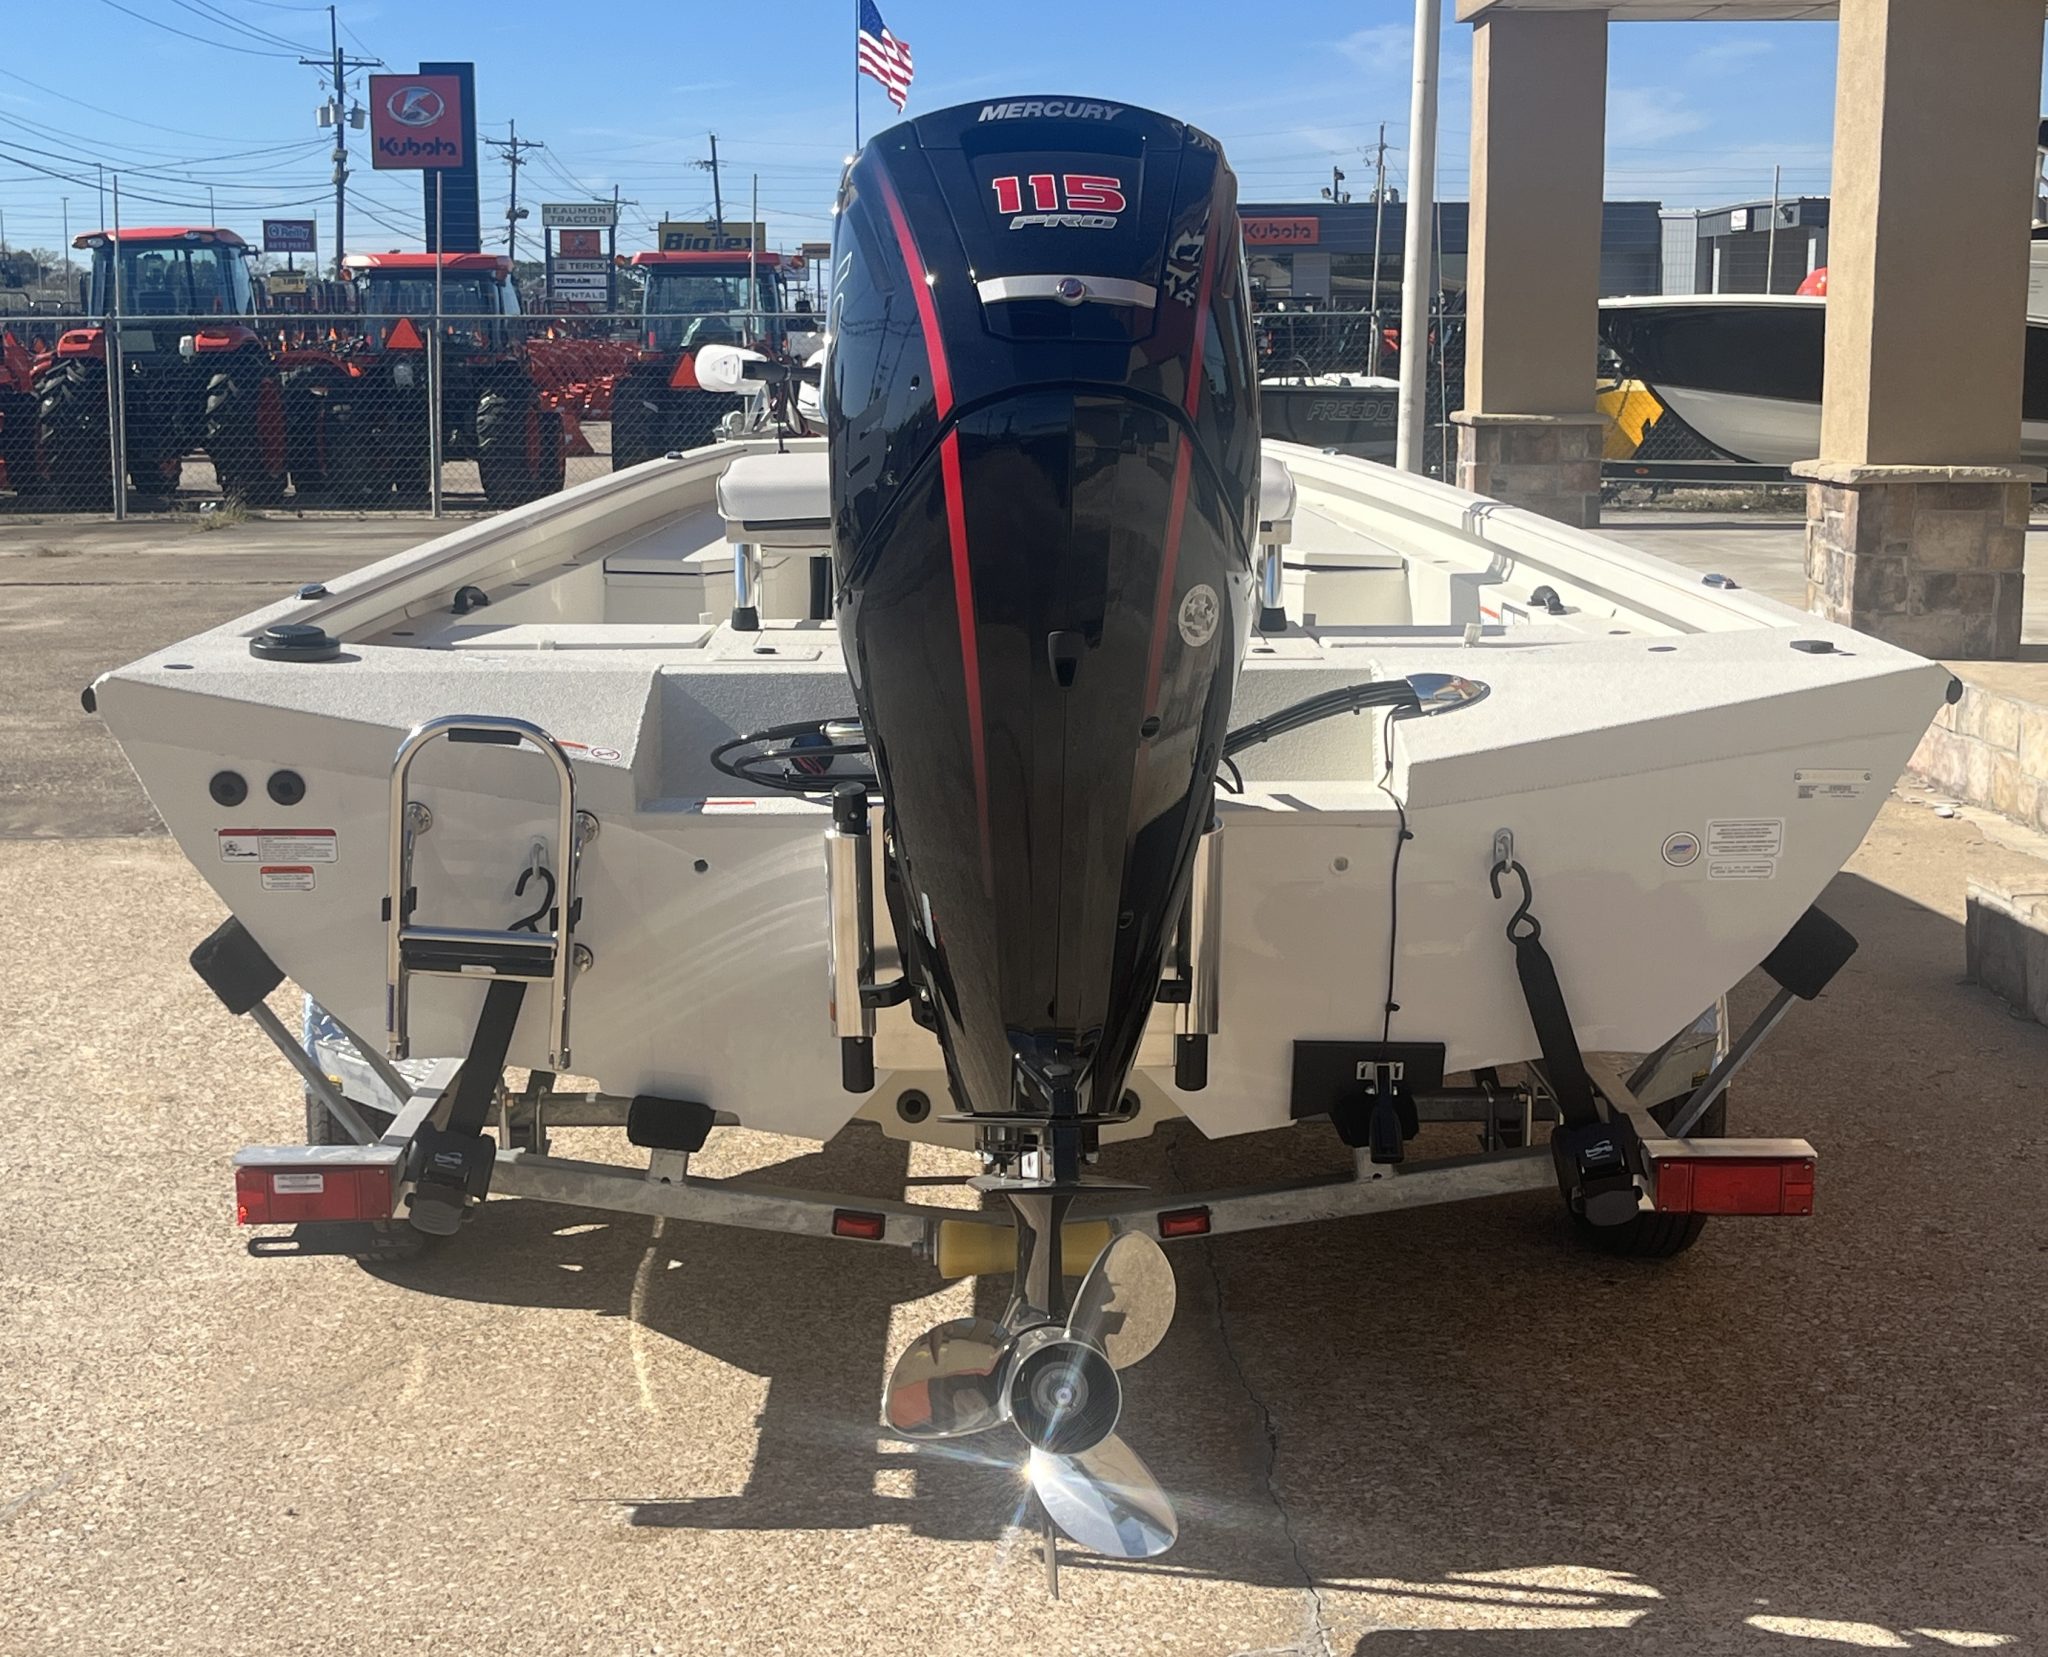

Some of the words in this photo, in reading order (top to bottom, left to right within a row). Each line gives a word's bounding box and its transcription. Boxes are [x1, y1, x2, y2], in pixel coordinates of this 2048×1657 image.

[978, 101, 1124, 122] MERCURY
[379, 137, 457, 156] Kubota
[992, 174, 1126, 213] 115
[544, 207, 613, 215] BEAUMONT
[1009, 214, 1118, 230] PRO
[1243, 223, 1312, 239] Kubota
[568, 262, 604, 270] TEREX
[1307, 400, 1396, 421] FREEDO
